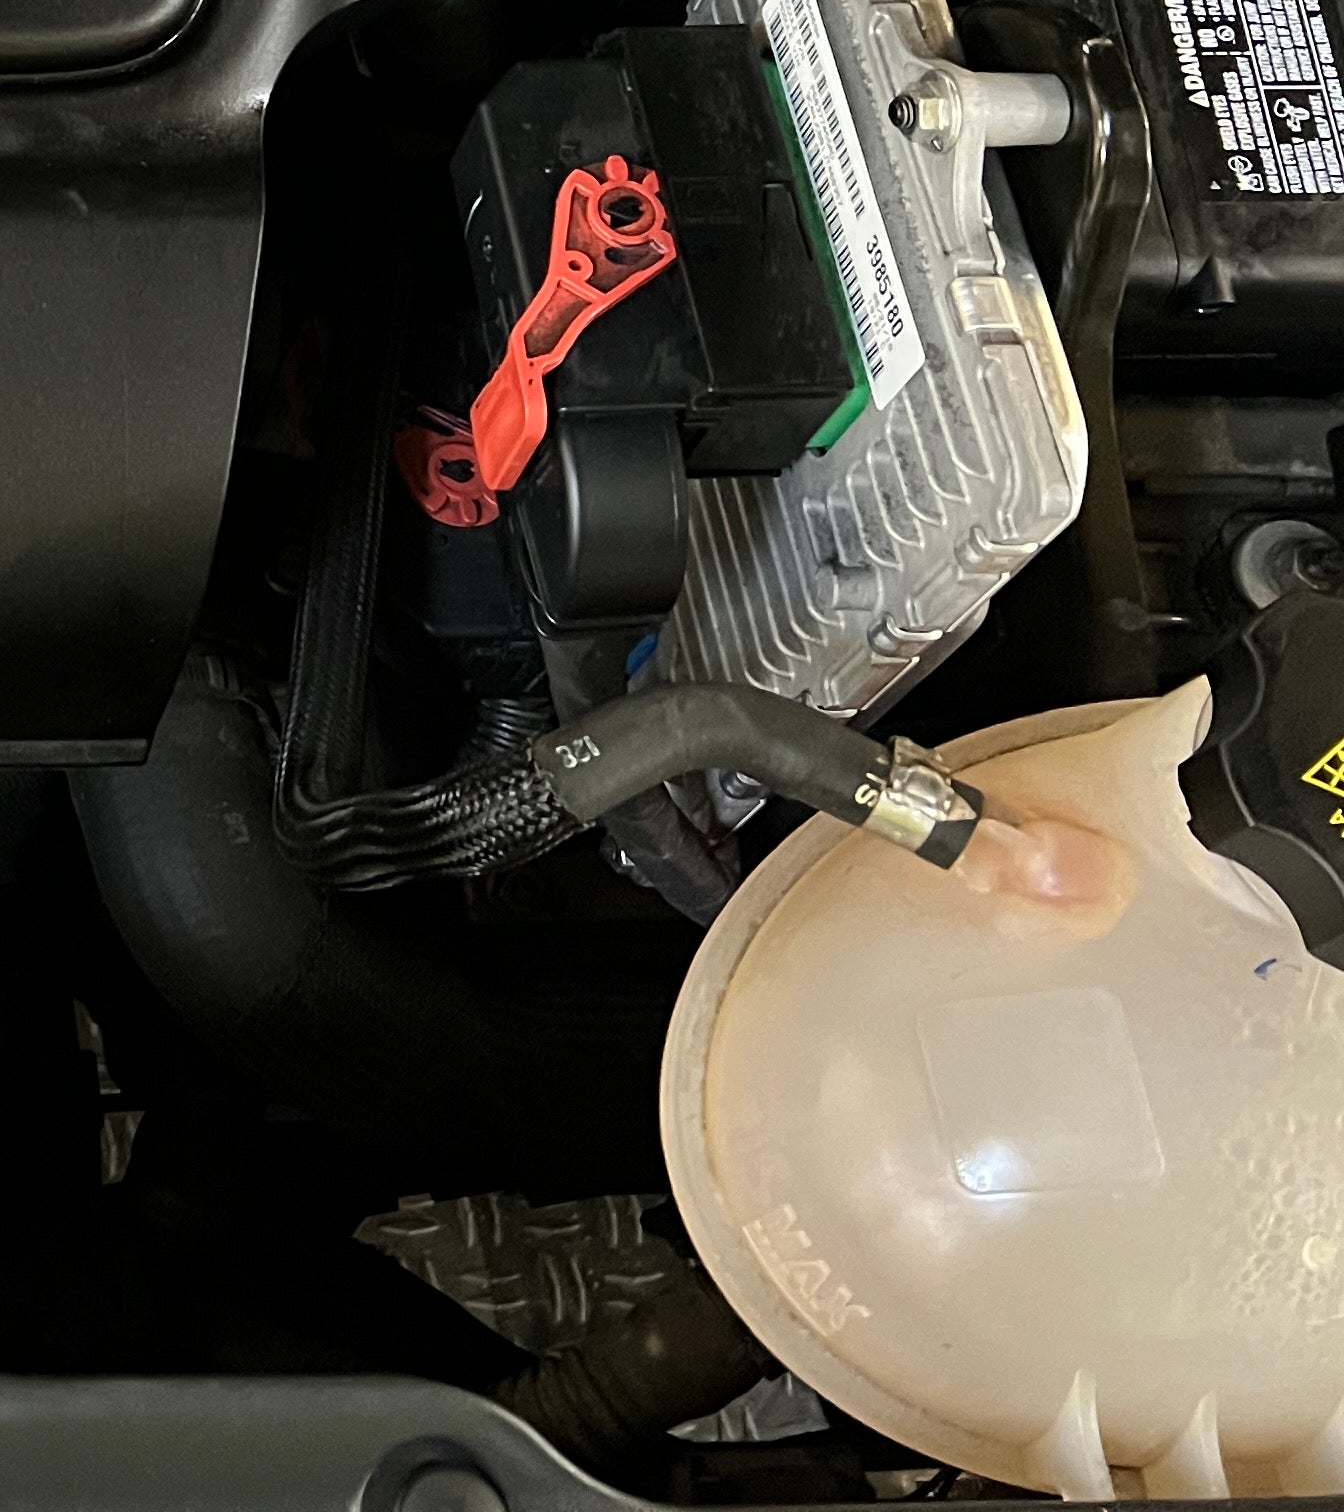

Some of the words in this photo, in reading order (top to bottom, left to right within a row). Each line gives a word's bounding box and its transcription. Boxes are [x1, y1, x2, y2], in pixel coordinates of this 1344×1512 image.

[1195, 28, 1219, 47] NO
[865, 230, 904, 342] 3985180
[752, 1203, 872, 1330] MAX
